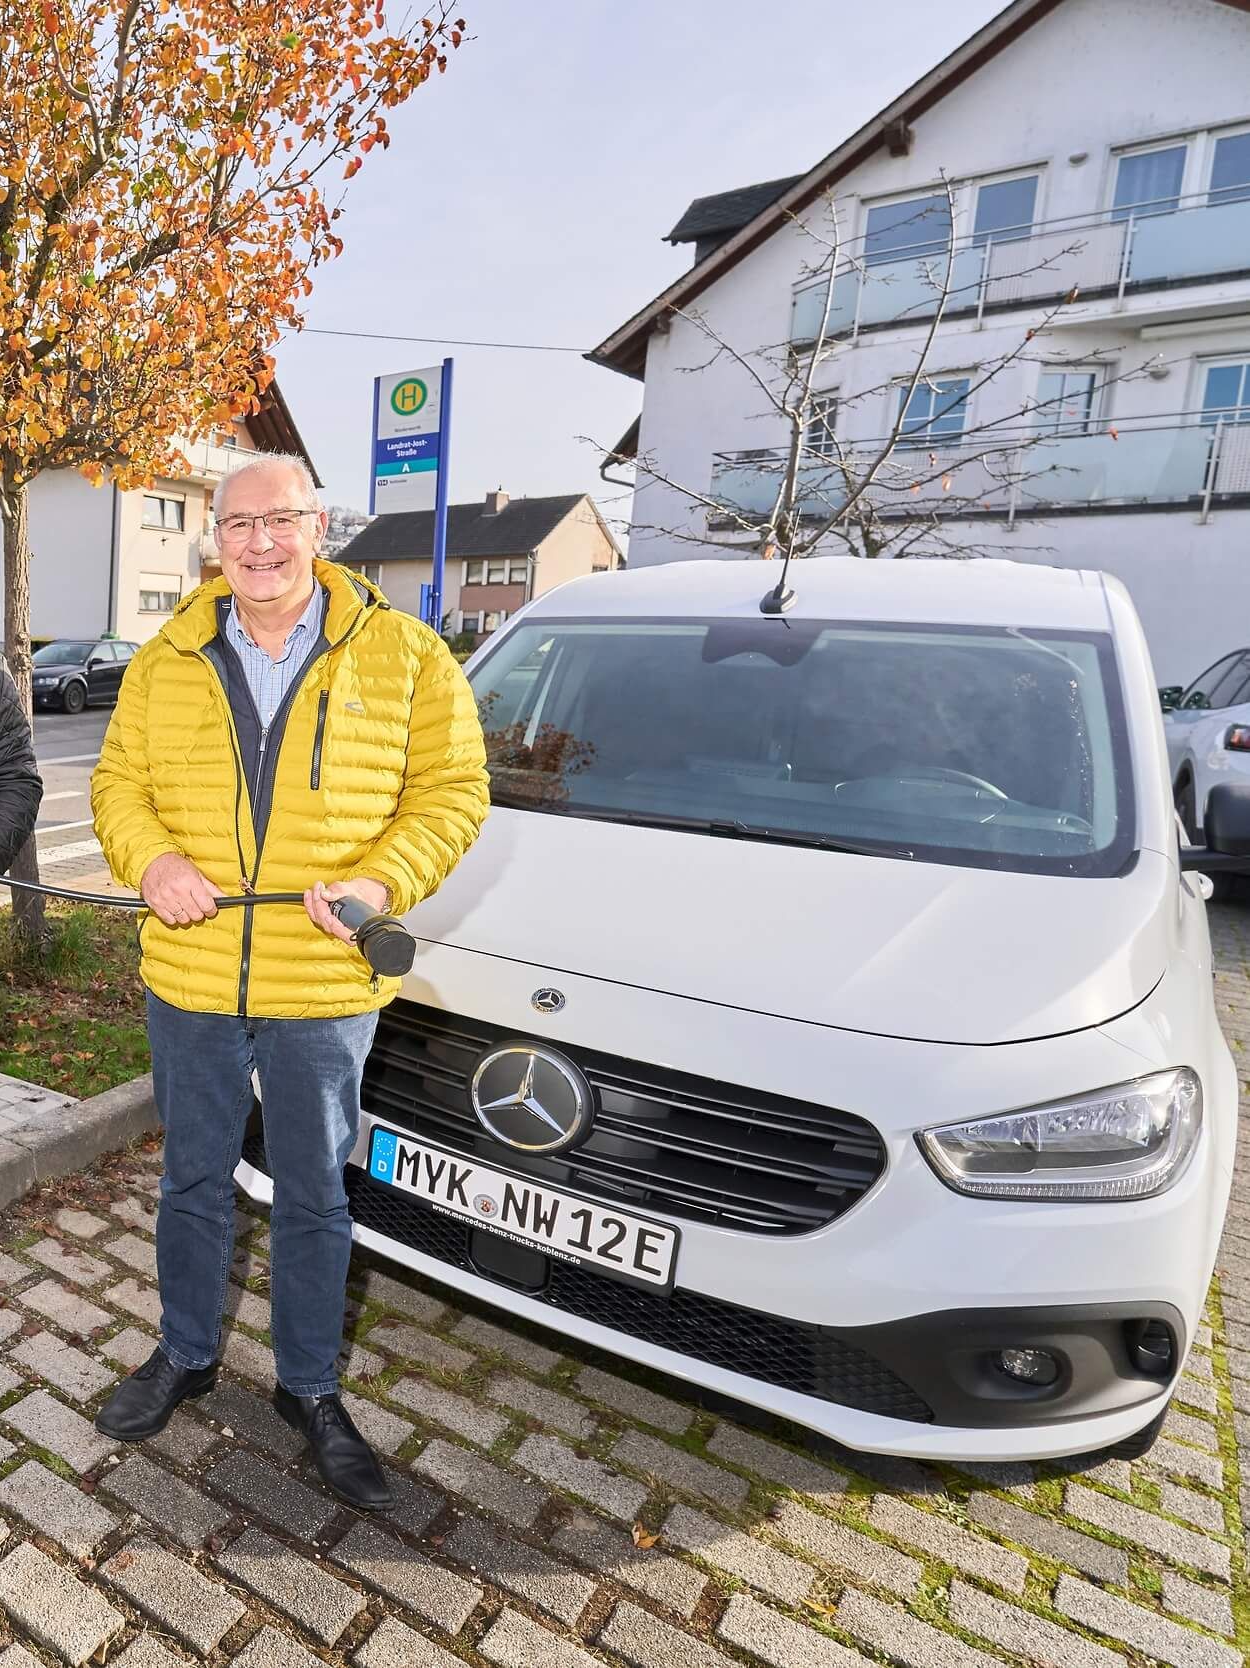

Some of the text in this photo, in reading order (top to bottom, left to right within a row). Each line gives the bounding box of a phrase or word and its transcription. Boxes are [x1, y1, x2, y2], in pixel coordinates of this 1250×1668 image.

[401, 385, 417, 409] H
[387, 439, 428, 451] Landrat-Jost-
[396, 447, 418, 457] Straße
[402, 463, 410, 473] A
[377, 1160, 388, 1173] D
[396, 1144, 666, 1277] MYK NW 12E
[432, 1203, 581, 1265] www.mercedes-benz-trucks-koblenz.de
